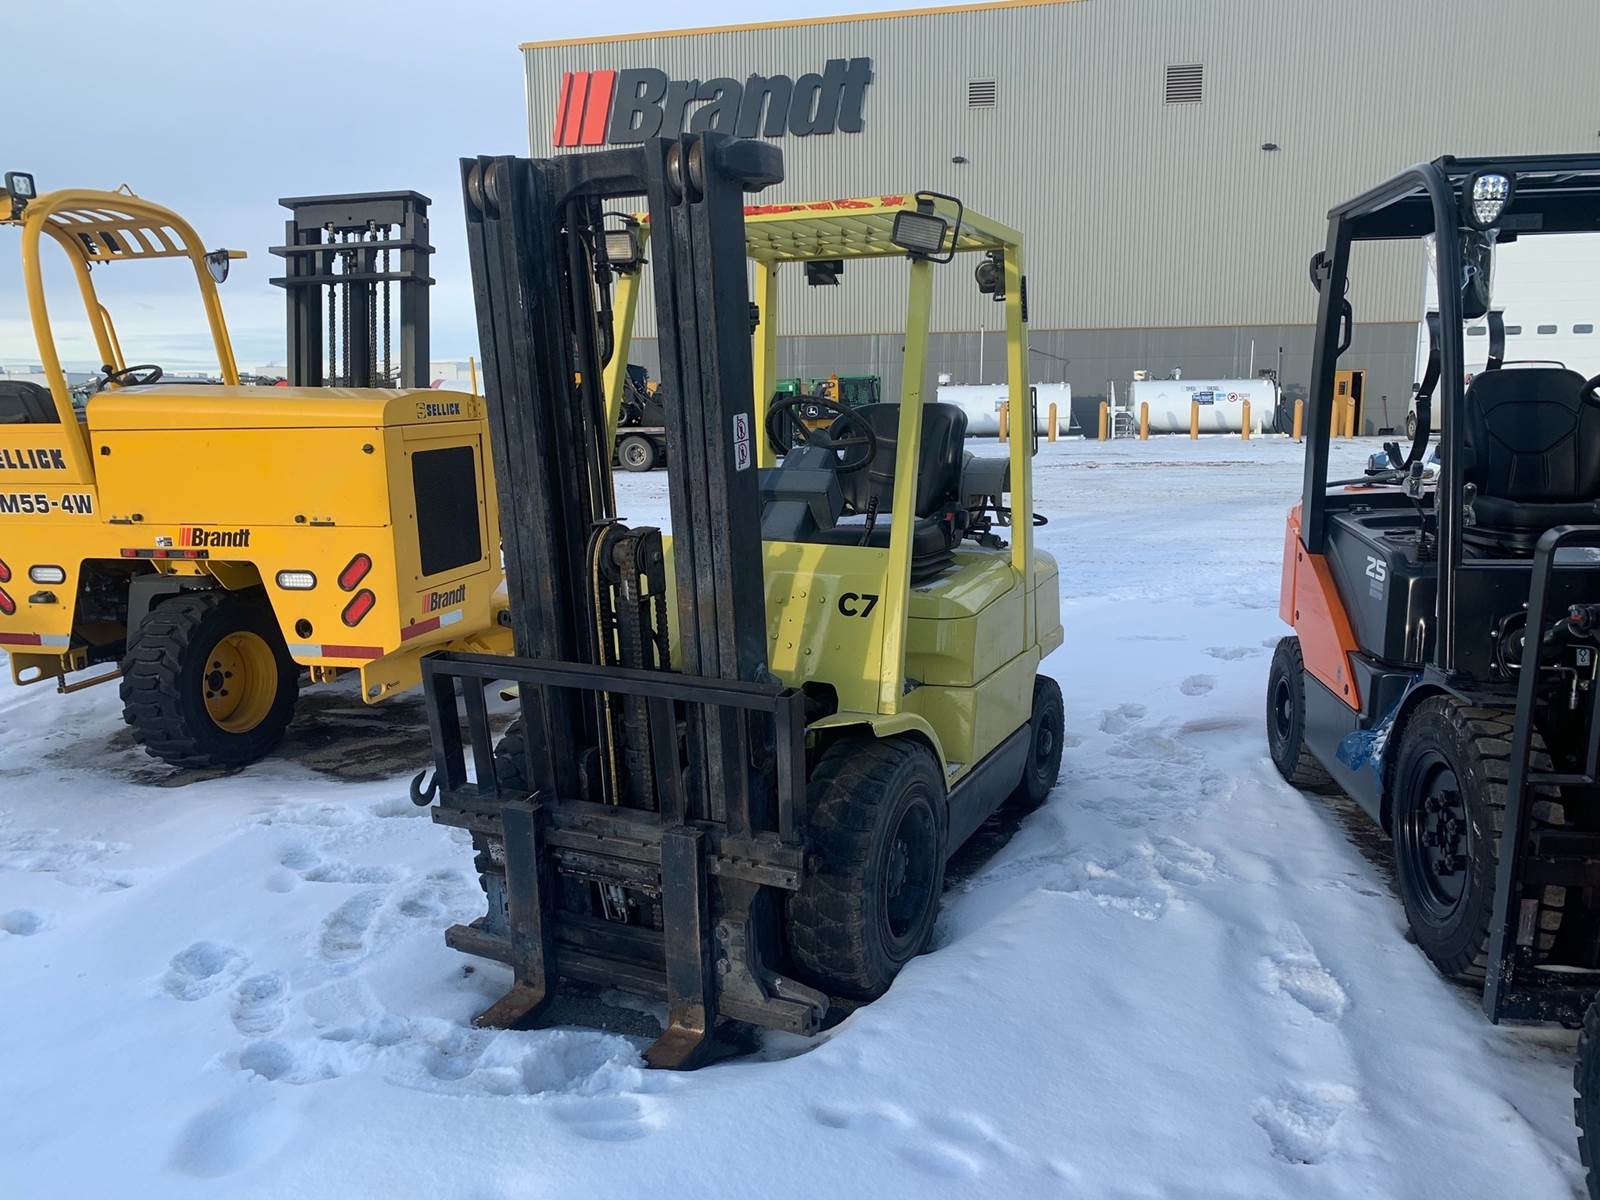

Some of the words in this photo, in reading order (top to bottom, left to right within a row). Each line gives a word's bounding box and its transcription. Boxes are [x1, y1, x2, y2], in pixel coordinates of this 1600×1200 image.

[608, 57, 873, 144] Brandt
[426, 402, 461, 417] SELLICK
[191, 527, 251, 547] Brandt
[1365, 555, 1387, 582] 25
[430, 583, 466, 612] Brandt
[838, 592, 879, 617] C7
